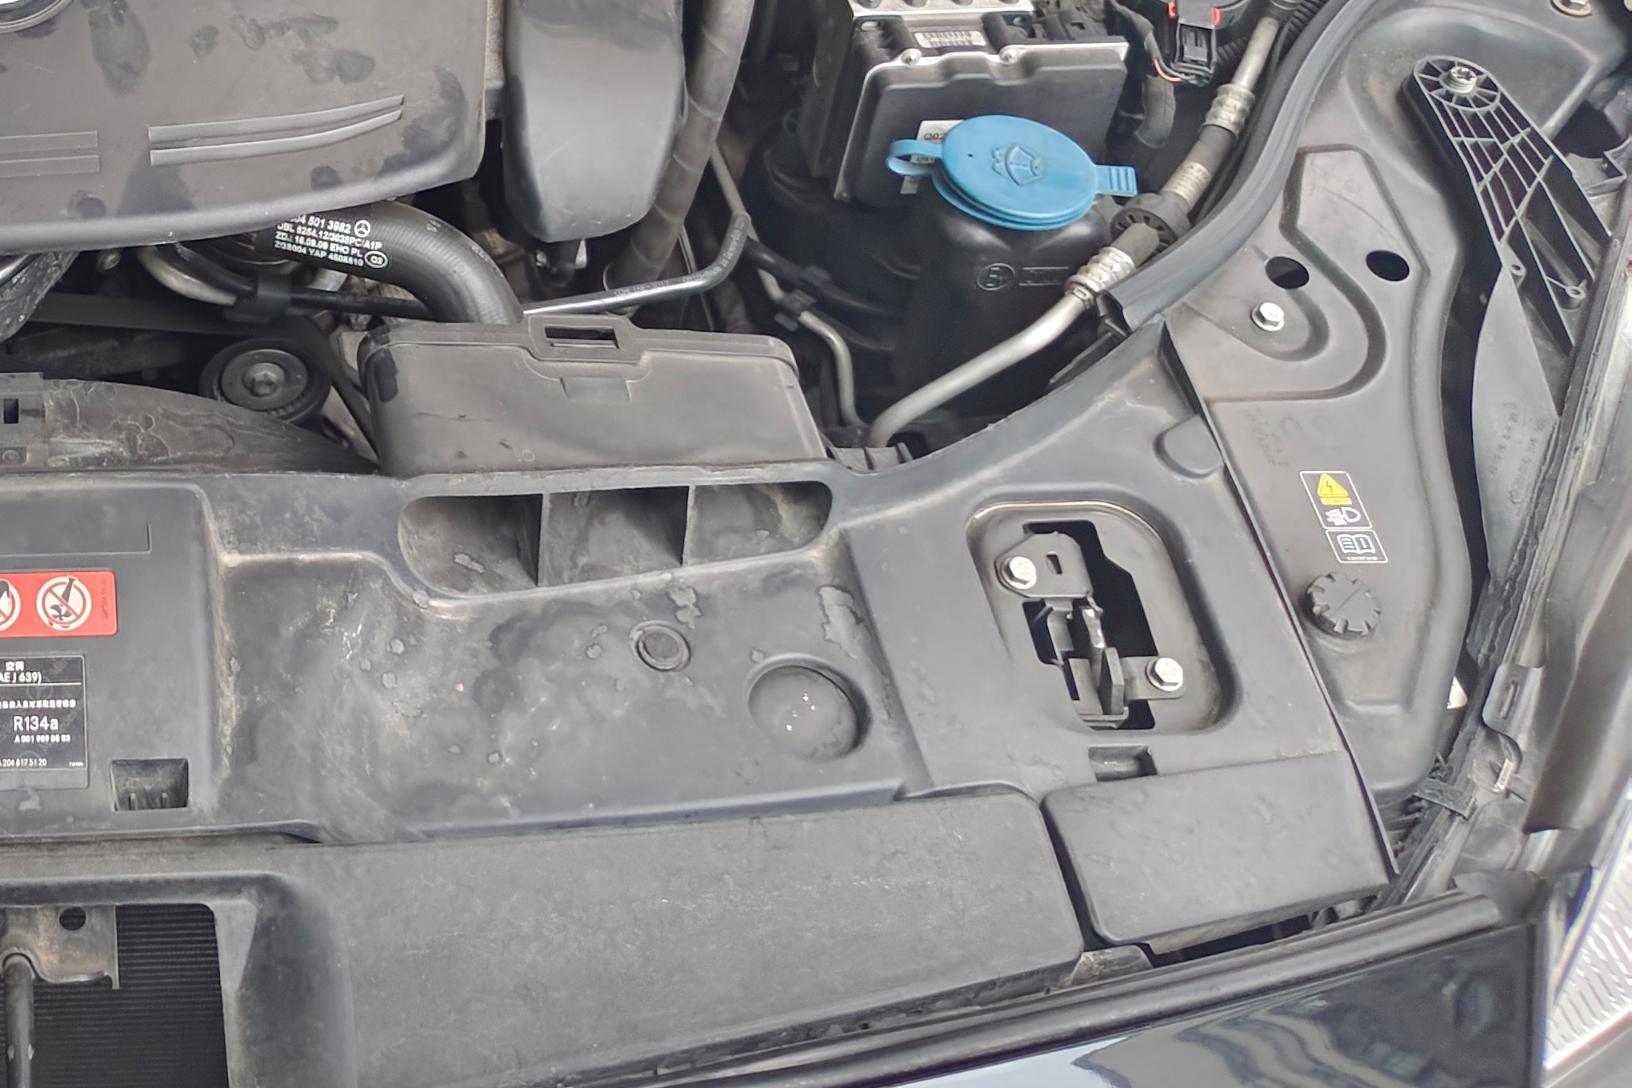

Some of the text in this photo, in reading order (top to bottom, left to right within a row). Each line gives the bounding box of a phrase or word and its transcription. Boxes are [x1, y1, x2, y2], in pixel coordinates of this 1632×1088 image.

[12, 672, 17, 683] J
[18, 671, 43, 684] 639)
[13, 715, 59, 731] R134a
